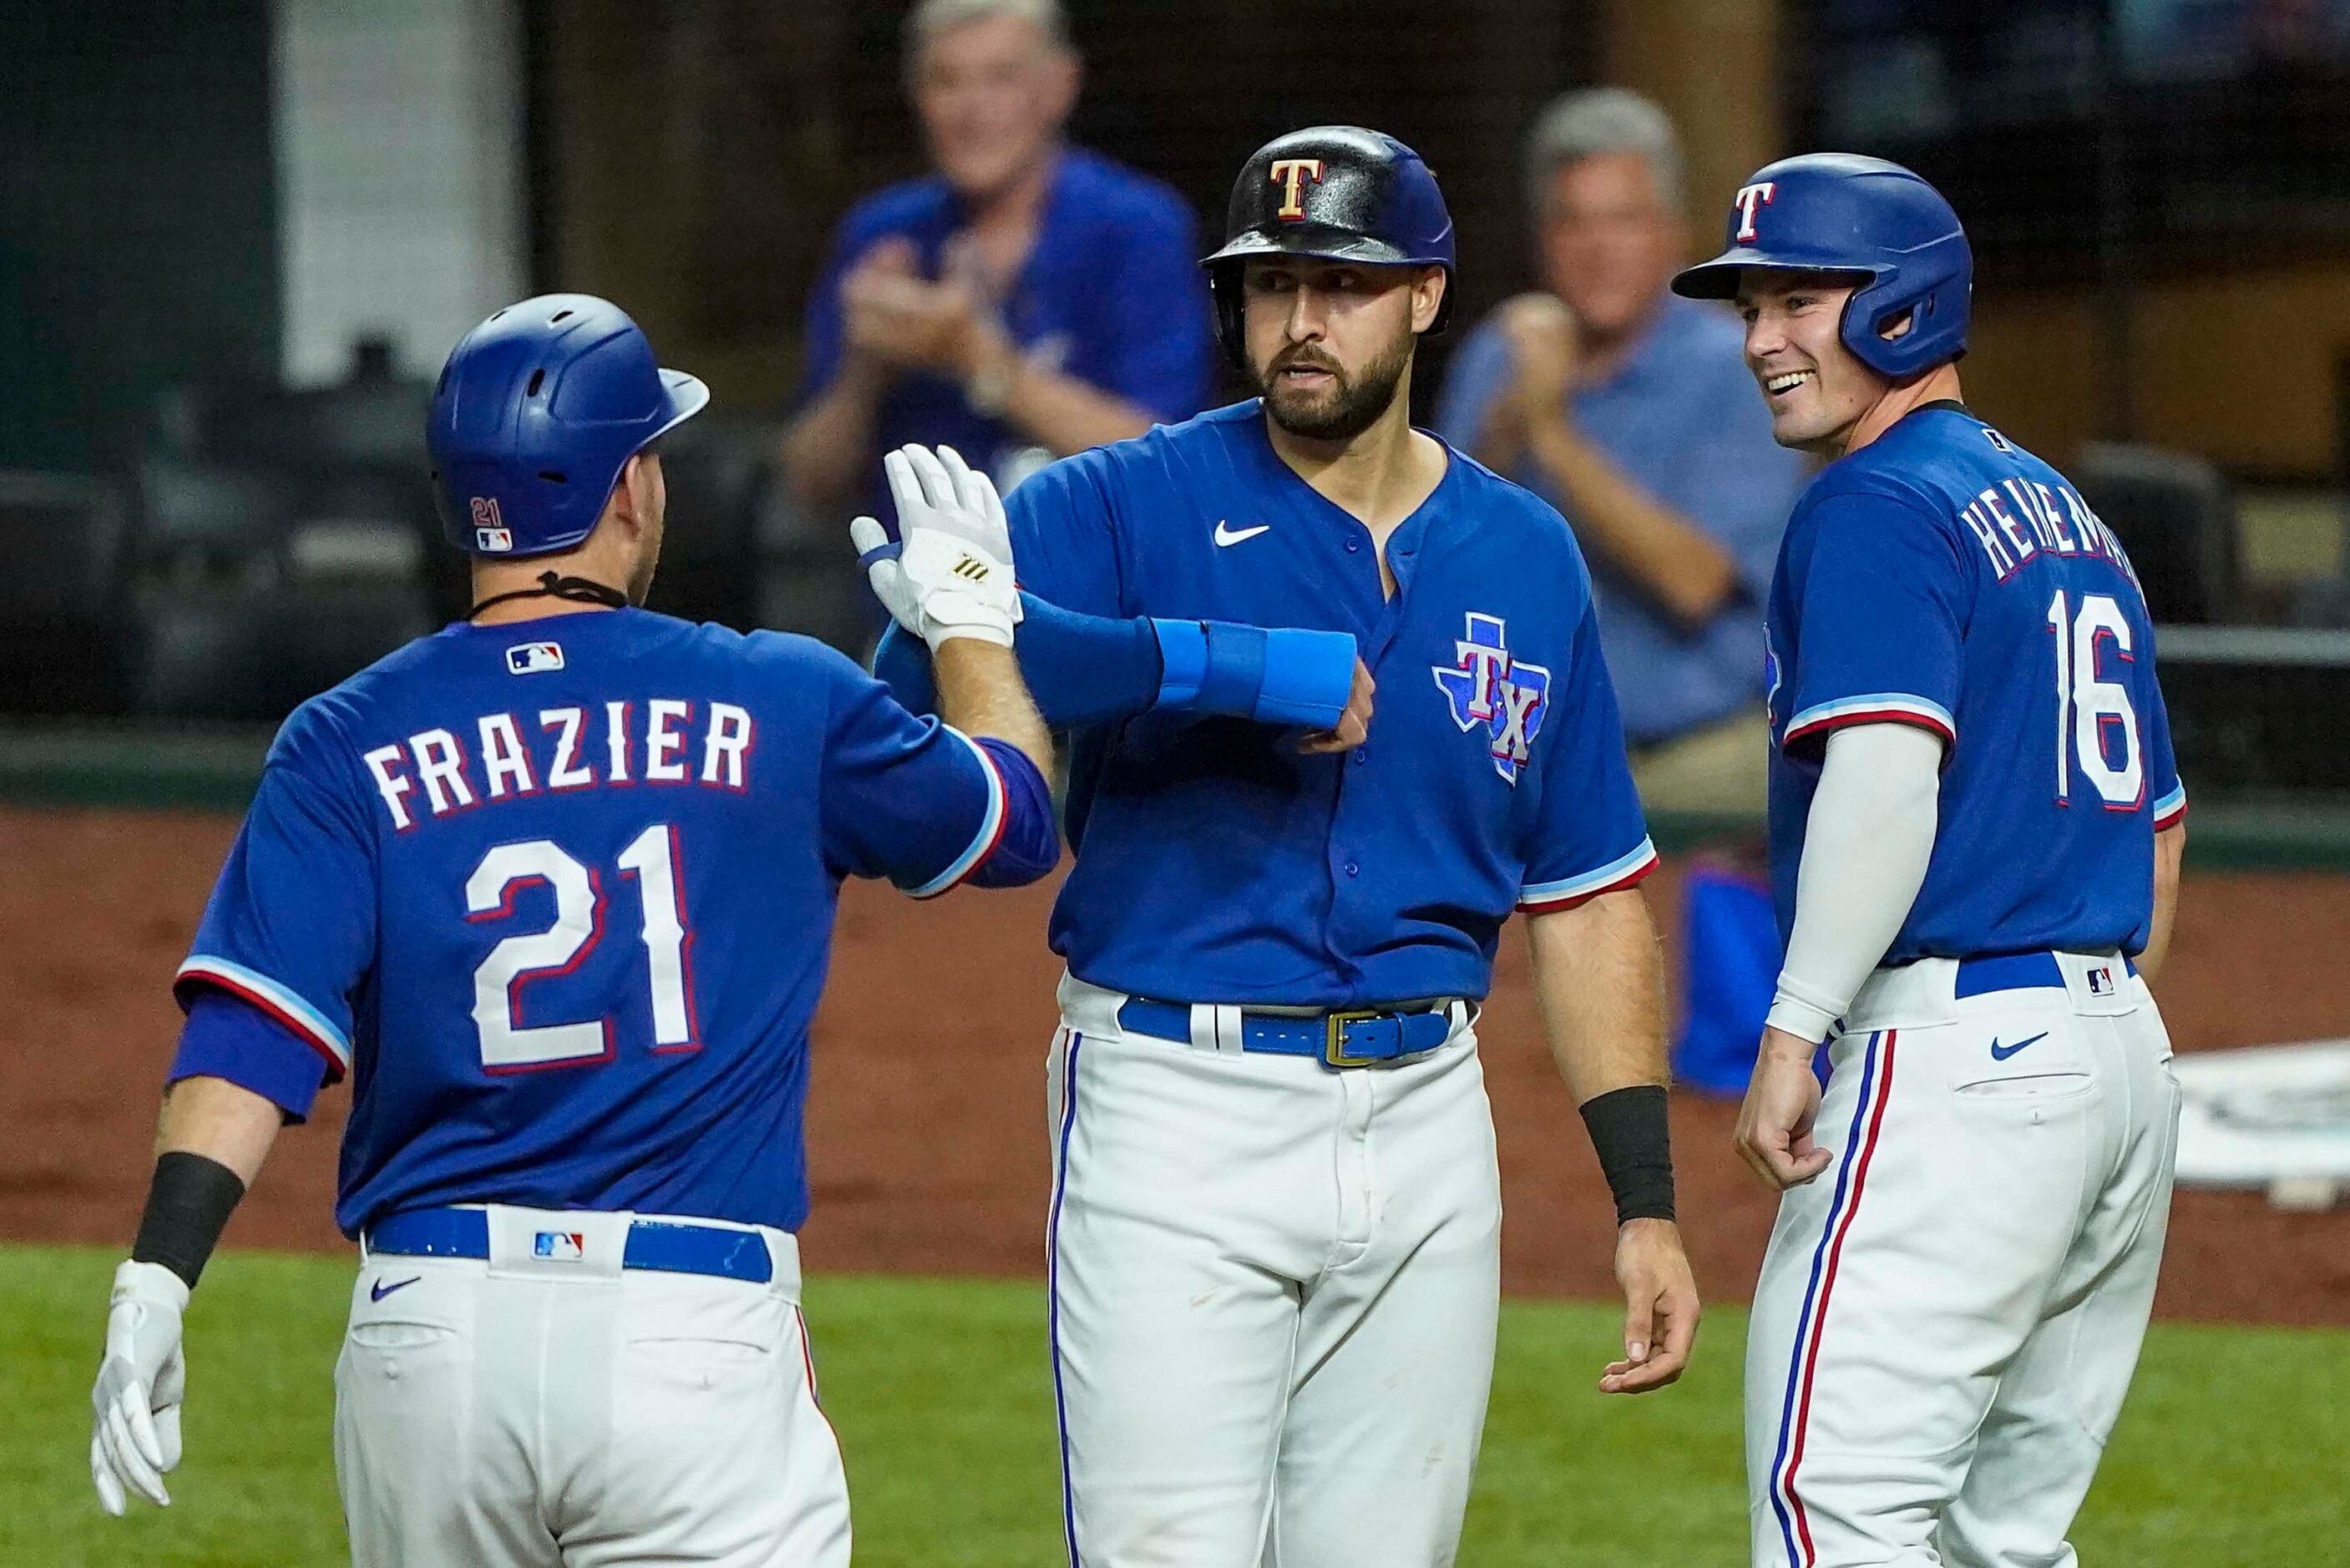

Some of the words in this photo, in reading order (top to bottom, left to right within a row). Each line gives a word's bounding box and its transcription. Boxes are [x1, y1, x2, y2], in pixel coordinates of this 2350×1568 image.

[1269, 159, 1324, 223] T
[1735, 182, 1776, 243] T
[469, 496, 502, 528] 21
[2047, 589, 2146, 812] 16
[363, 699, 755, 835] FRAZIER
[464, 823, 704, 1076] 21
